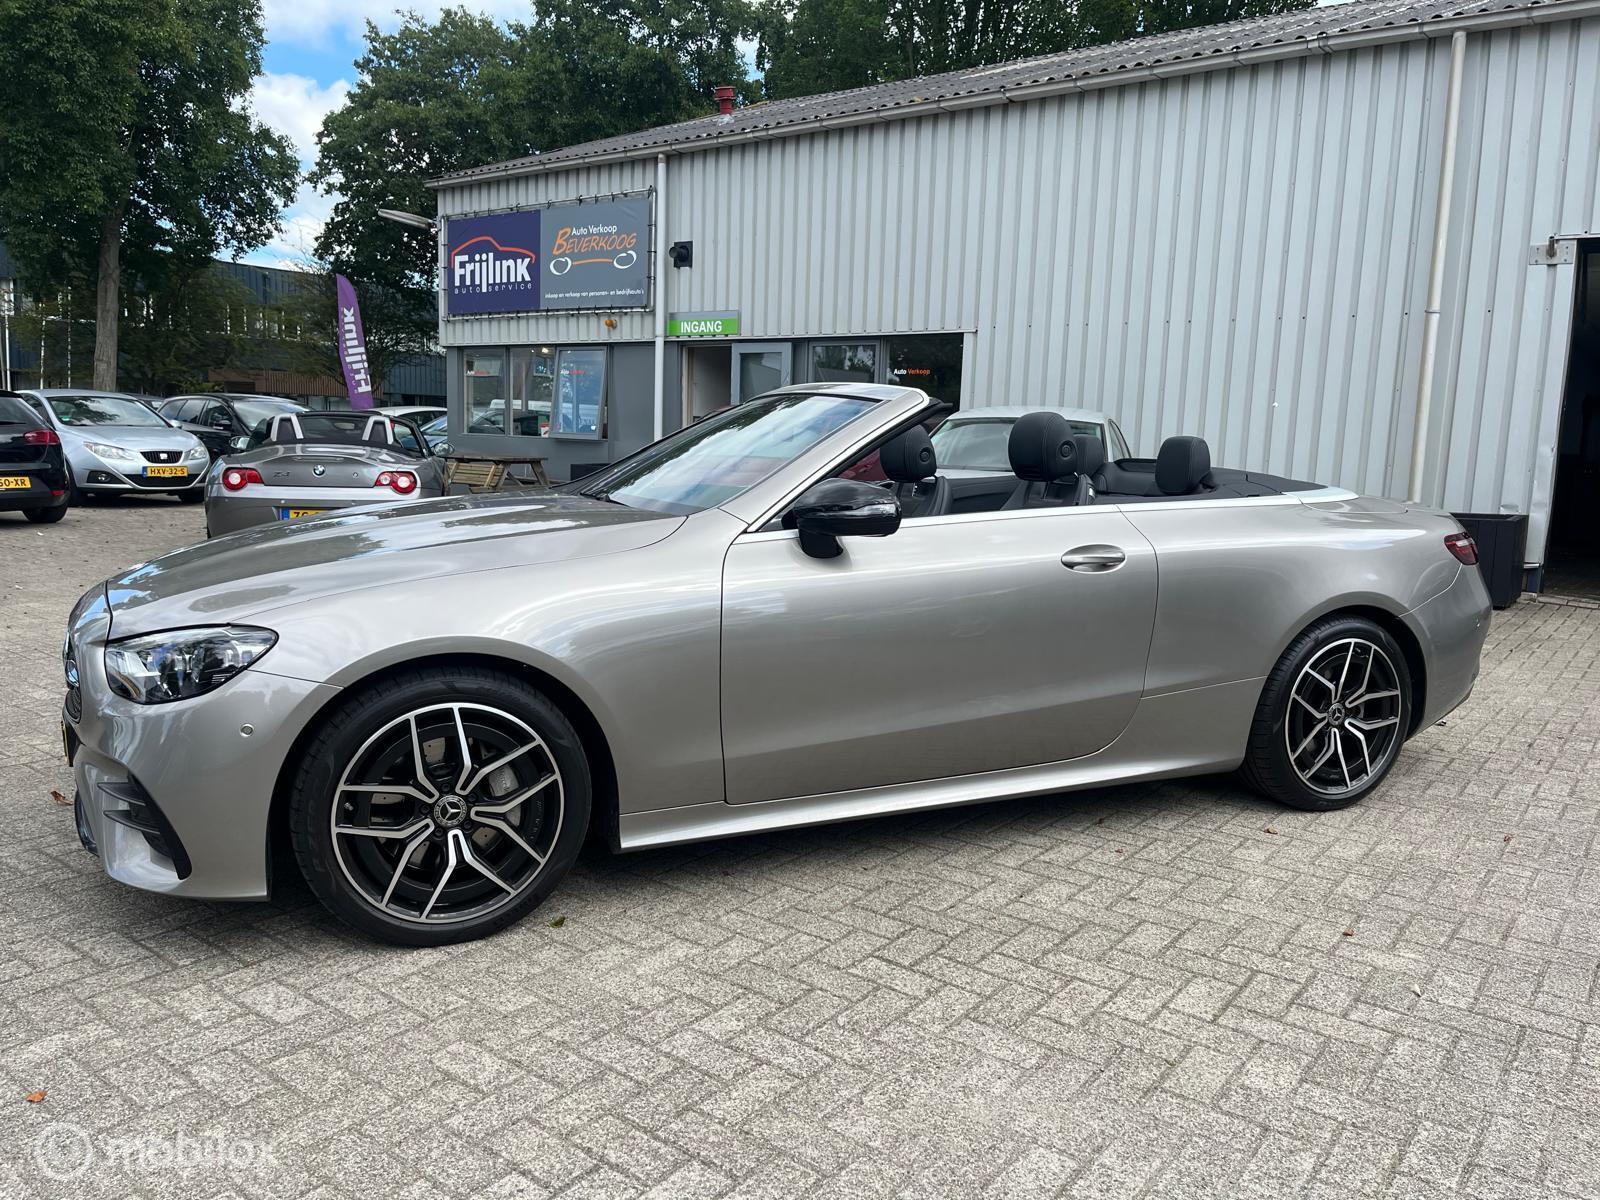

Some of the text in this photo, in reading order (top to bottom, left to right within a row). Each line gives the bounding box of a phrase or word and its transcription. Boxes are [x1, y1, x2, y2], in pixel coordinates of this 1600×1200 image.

[571, 223, 618, 236] Auto Verkoop
[552, 227, 637, 256] BEVERKOOG
[454, 283, 532, 295] auto service
[681, 320, 722, 333] INGANG
[907, 368, 931, 376] Verkoop
[150, 467, 185, 475] HXV-32-S
